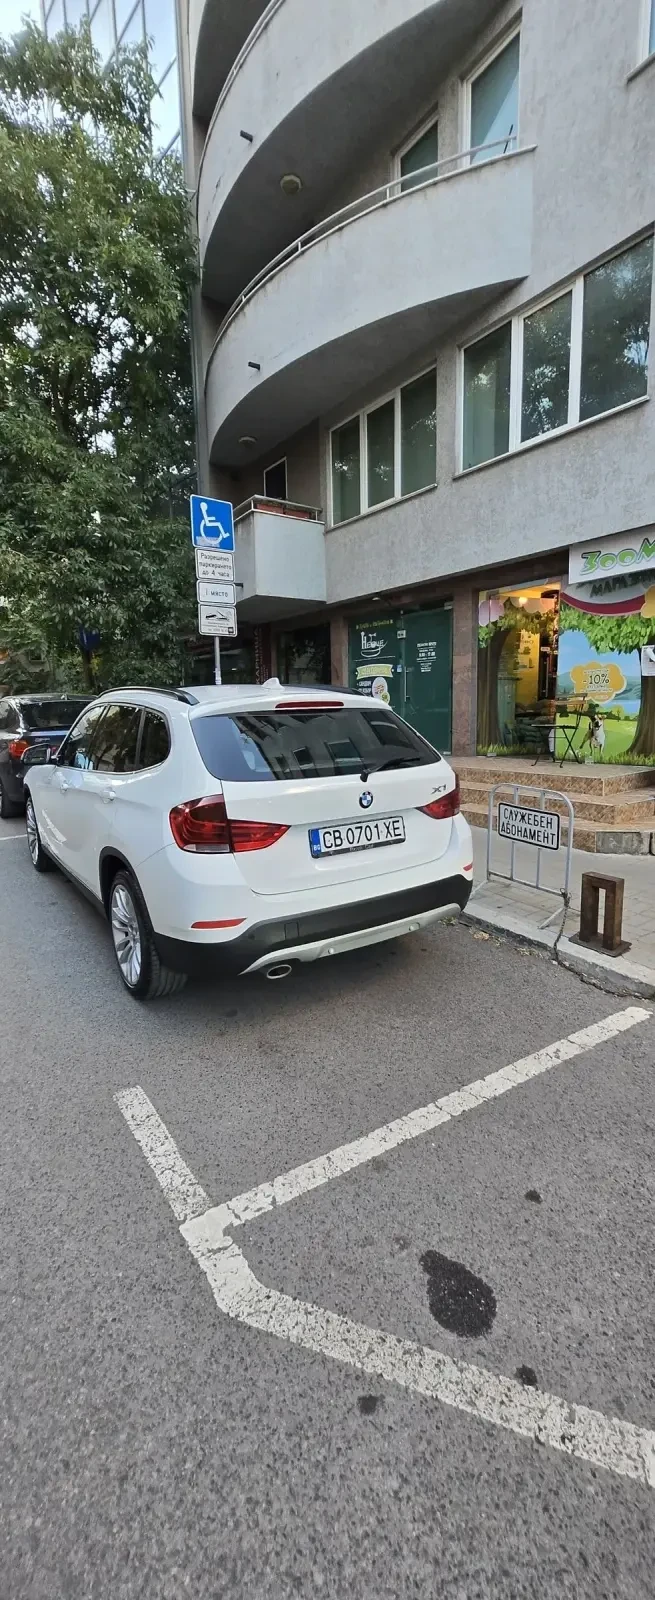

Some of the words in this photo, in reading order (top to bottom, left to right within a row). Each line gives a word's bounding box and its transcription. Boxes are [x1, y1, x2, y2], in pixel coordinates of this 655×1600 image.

[201, 552, 230, 562] Разрешено
[211, 590, 229, 598] място
[431, 784, 447, 794] X1
[503, 807, 554, 830] СЛУЖЕБЕН
[346, 823, 381, 845] 0701
[500, 821, 556, 846] АБОНАМЕНТ
